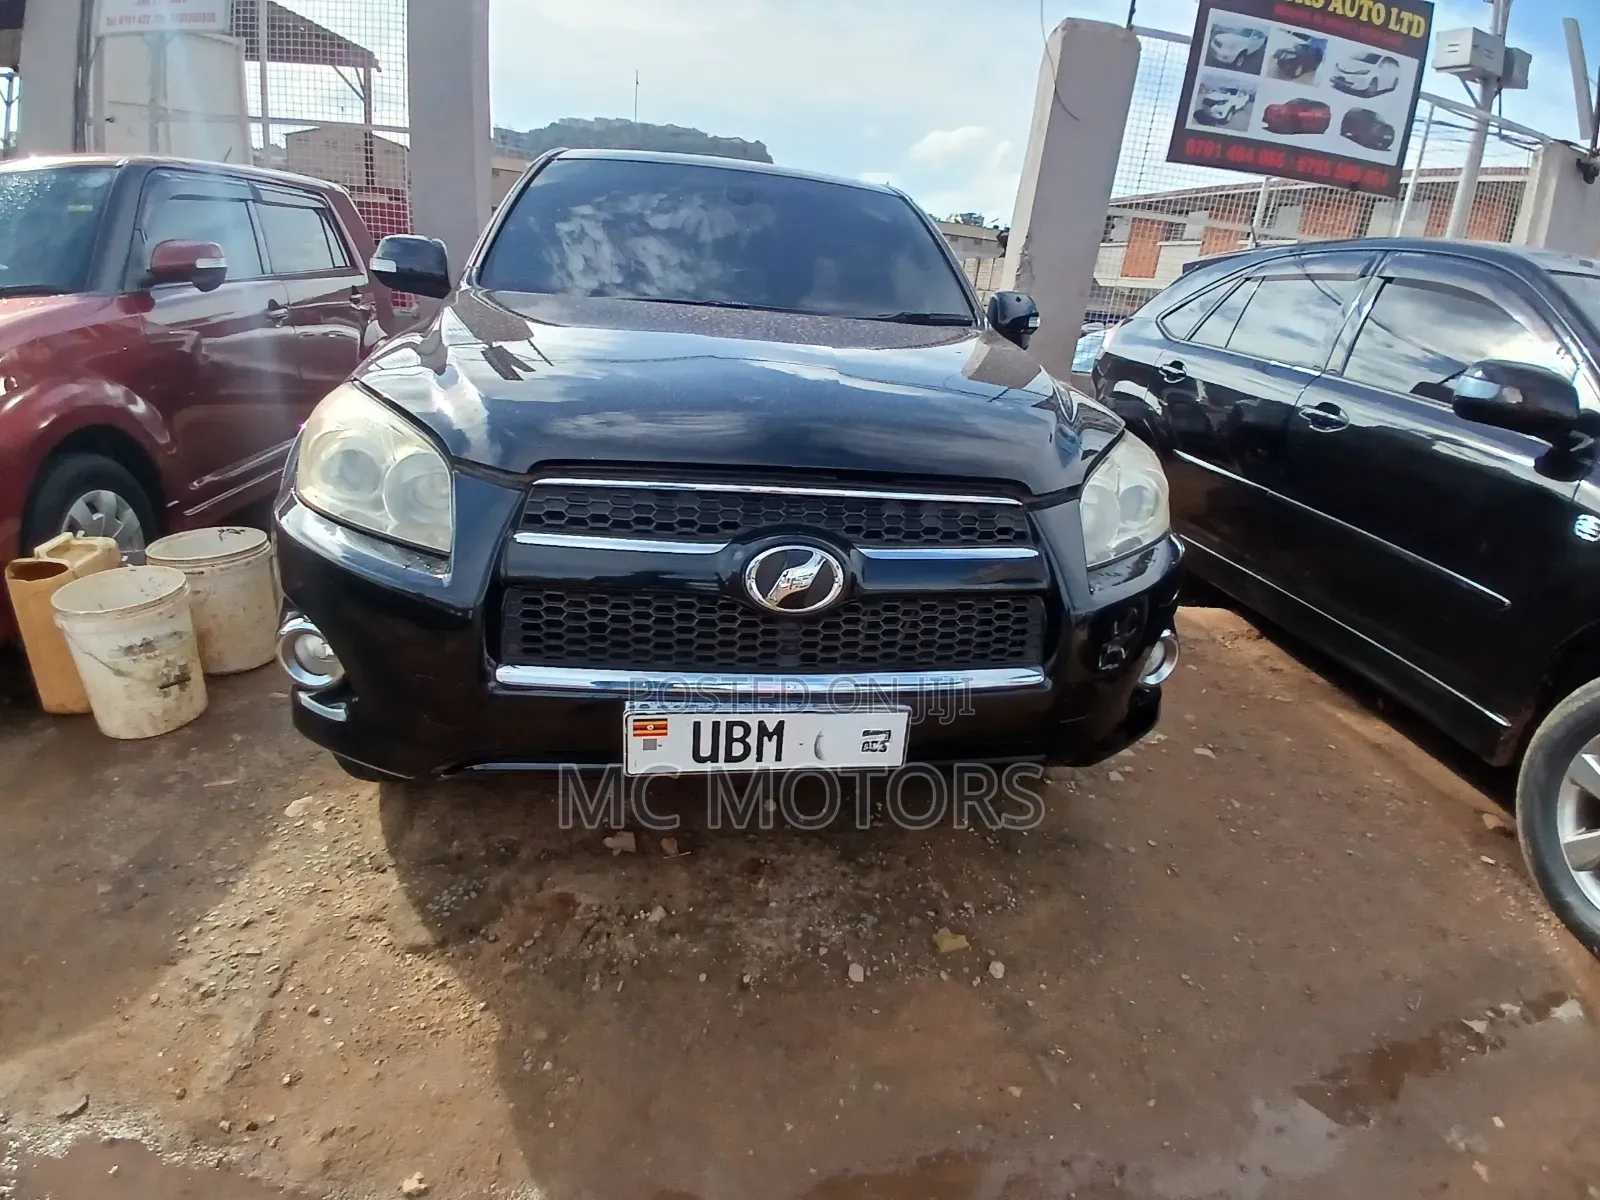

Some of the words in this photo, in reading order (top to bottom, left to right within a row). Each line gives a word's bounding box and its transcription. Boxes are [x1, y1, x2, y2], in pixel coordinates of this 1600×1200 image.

[1327, 0, 1386, 25] AUTO
[1388, 7, 1425, 39] LTD
[692, 720, 785, 763] UBM
